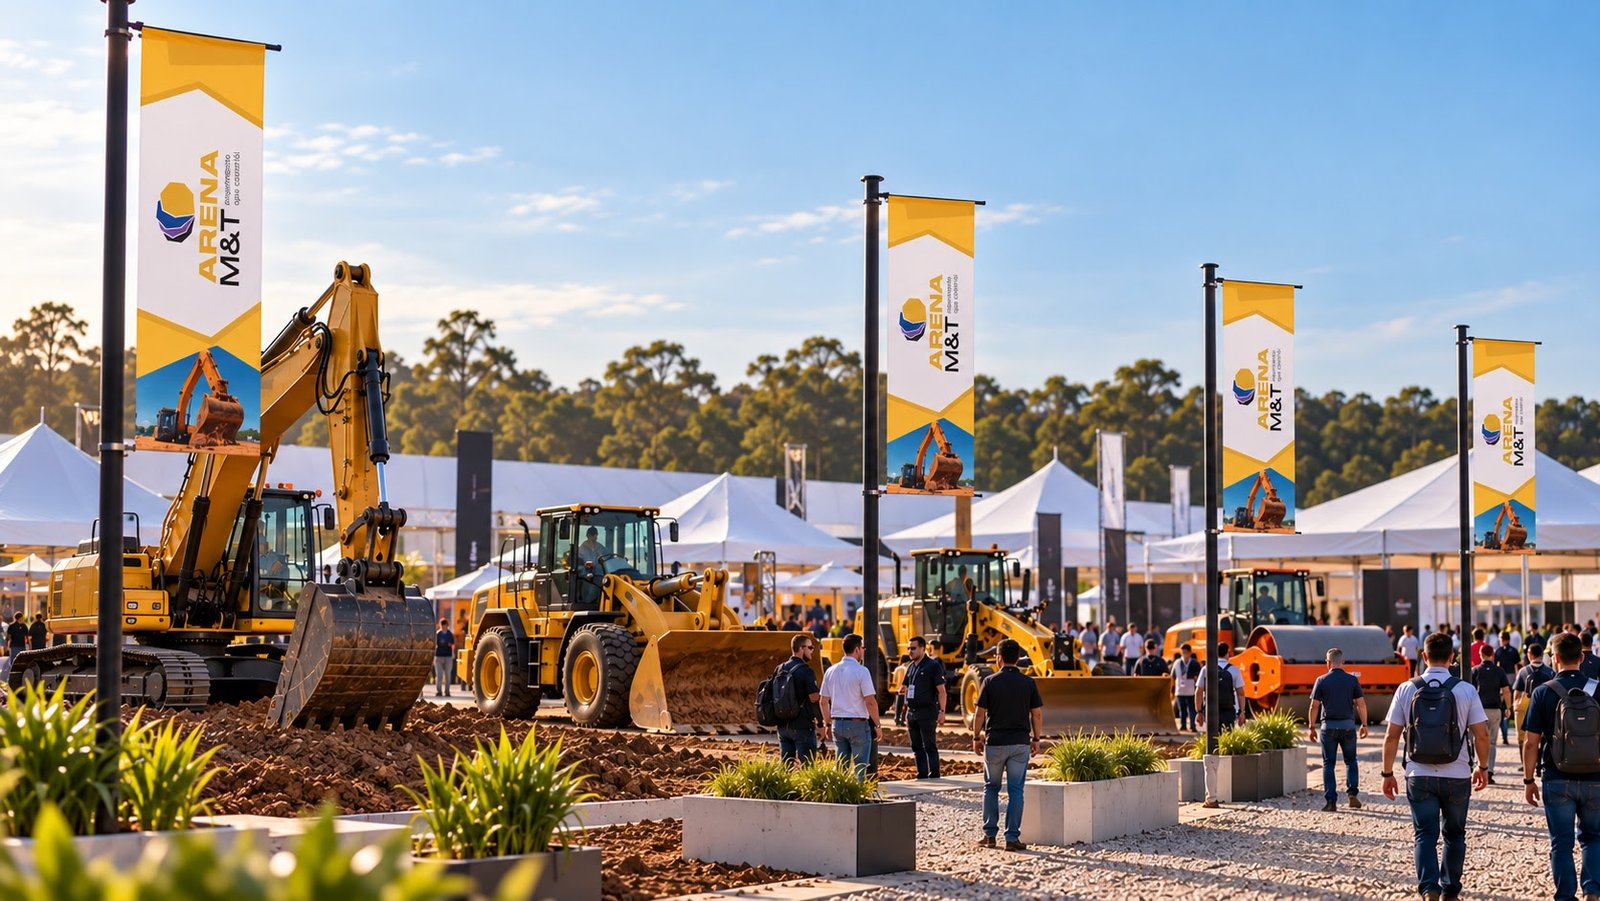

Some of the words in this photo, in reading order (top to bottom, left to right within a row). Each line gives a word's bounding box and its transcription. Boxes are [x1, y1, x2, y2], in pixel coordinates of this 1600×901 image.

[198, 150, 218, 283] ARENA
[220, 208, 240, 286] M&T
[929, 274, 943, 370] ARENA
[945, 316, 959, 372] M&T
[1257, 348, 1269, 430] ARENA
[1270, 383, 1282, 431] M&T
[1503, 396, 1513, 465] ARENA
[1513, 426, 1524, 466] M&T
